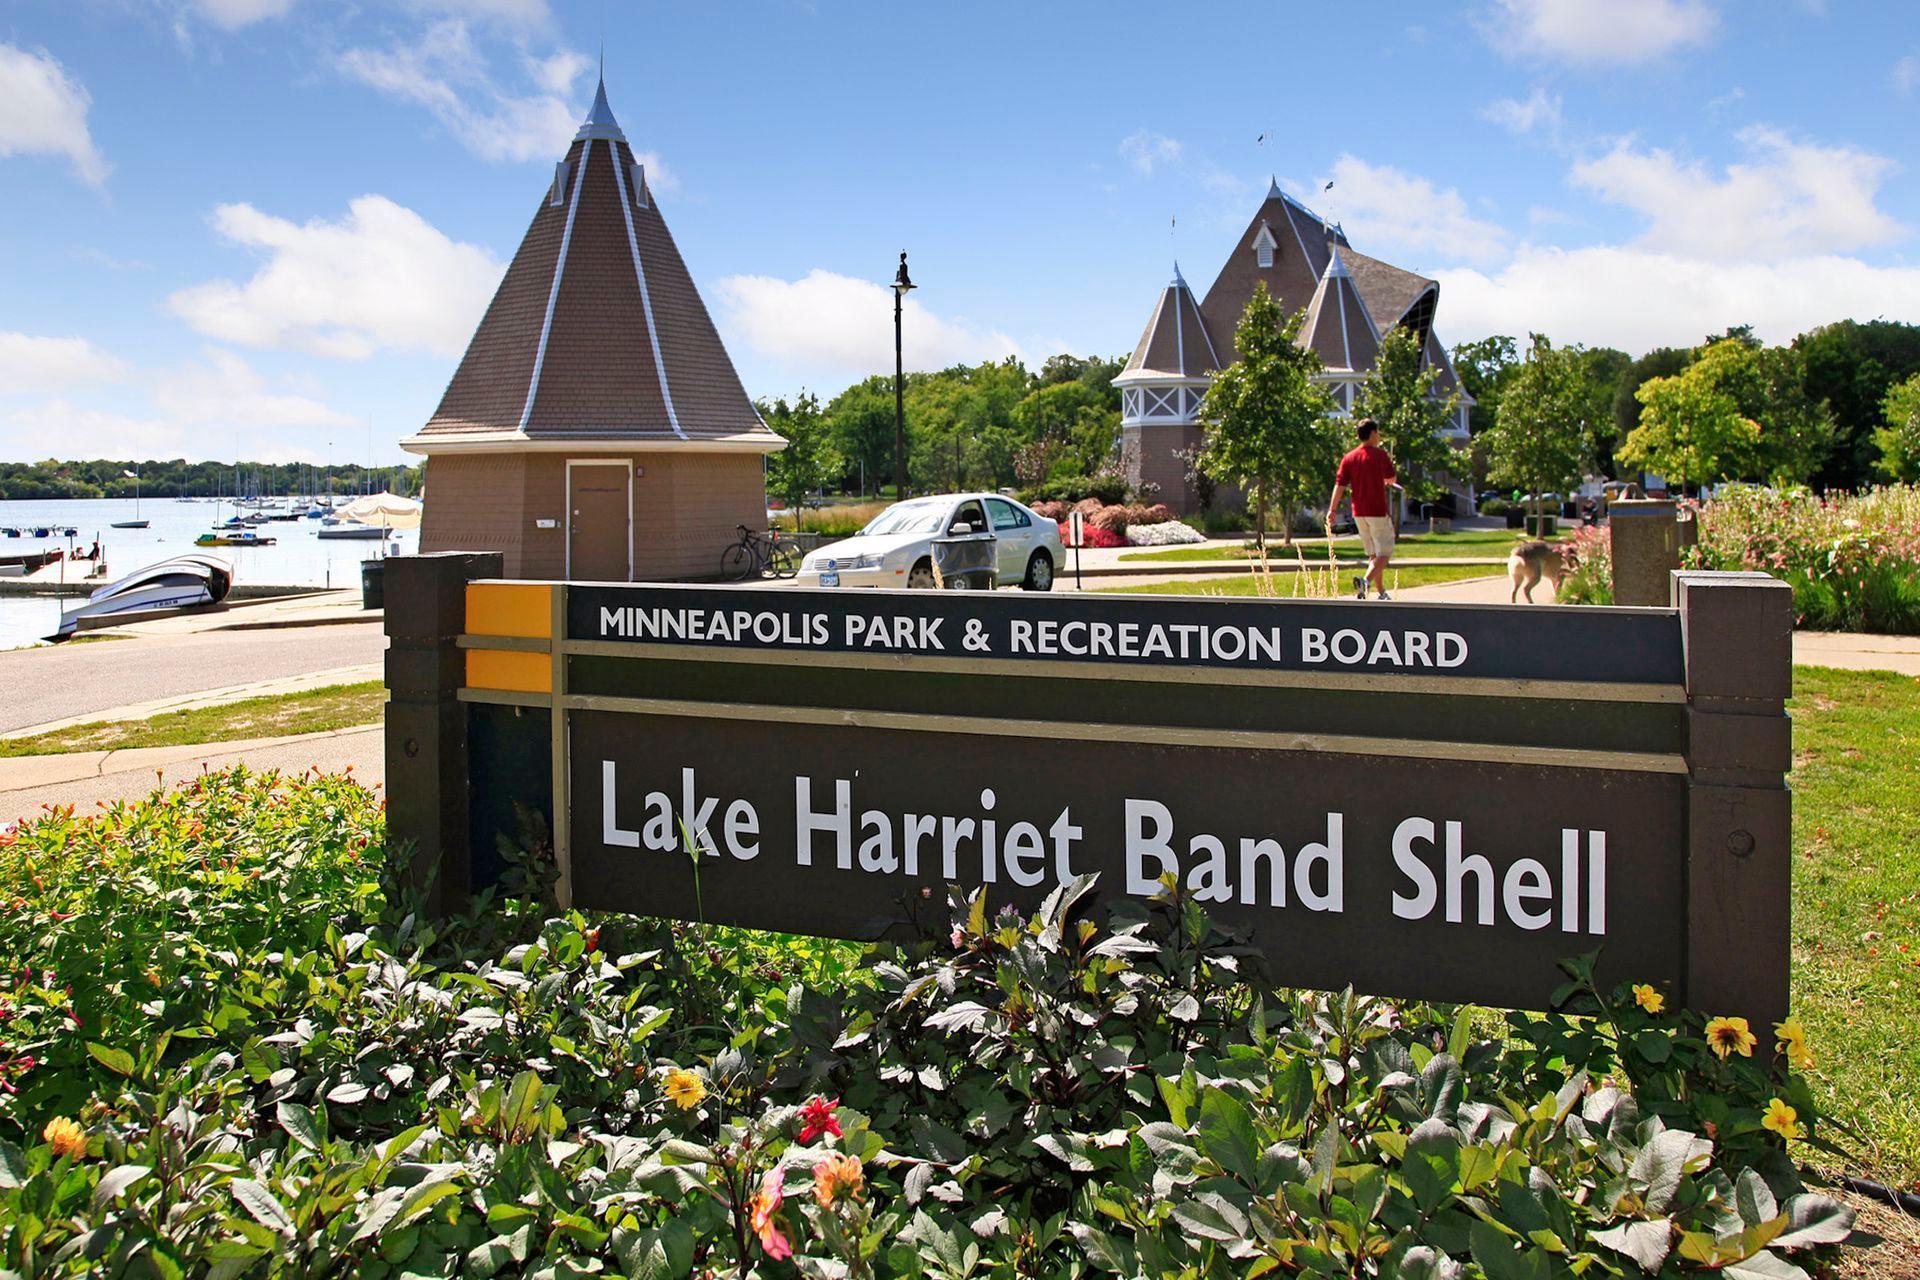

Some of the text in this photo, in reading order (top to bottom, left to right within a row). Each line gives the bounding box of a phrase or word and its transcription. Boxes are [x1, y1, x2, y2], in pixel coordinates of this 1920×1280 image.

[600, 606, 1468, 668] MINNEAPOLIS PARK & RECREATION BOARD
[602, 760, 1607, 936] Lake Harriet Band Shell
